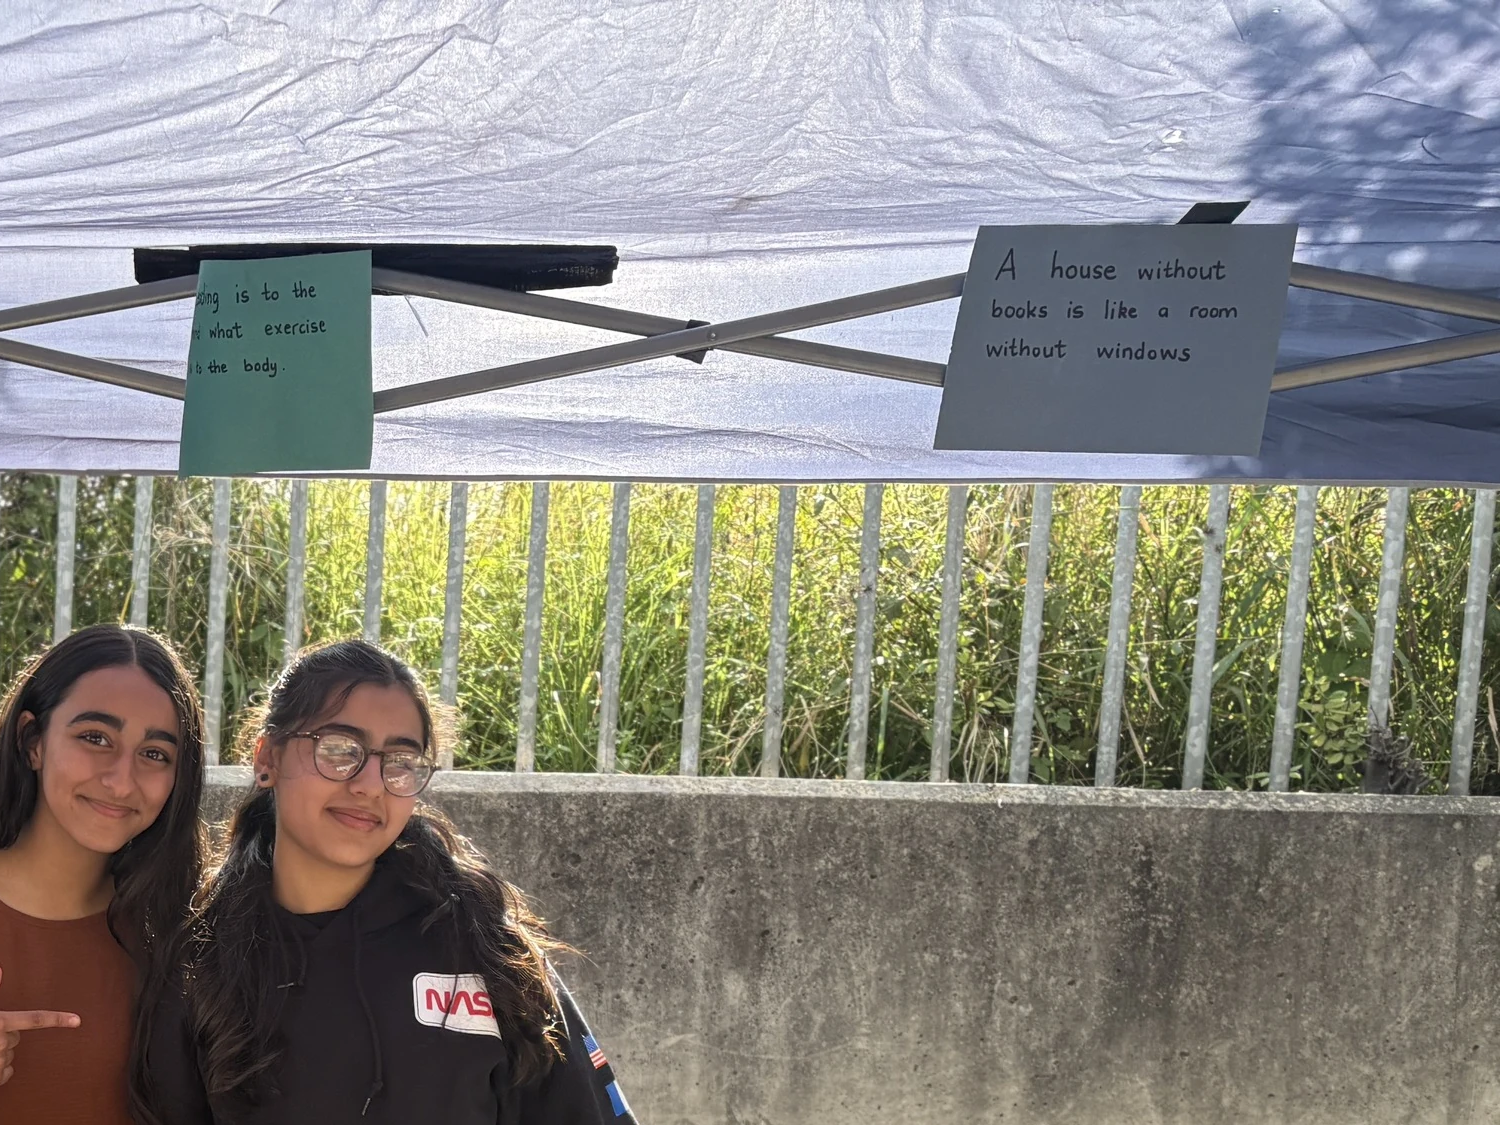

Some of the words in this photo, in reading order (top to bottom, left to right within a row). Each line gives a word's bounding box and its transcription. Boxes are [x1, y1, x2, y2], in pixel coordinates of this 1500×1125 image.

[995, 247, 1016, 281] A
[1050, 250, 1117, 281] house
[1137, 258, 1227, 281] without
[235, 284, 250, 304] is
[261, 282, 280, 301] to
[292, 281, 317, 299] the
[991, 299, 1048, 319] books
[1066, 300, 1085, 319] is
[1104, 299, 1139, 320] like
[1158, 305, 1169, 319] a
[1189, 304, 1238, 319] room
[209, 322, 243, 339] what
[264, 318, 327, 336] exercise
[986, 338, 1067, 359] without
[1097, 341, 1192, 362] windows
[207, 359, 228, 374] the
[425, 987, 496, 1019] NAS
